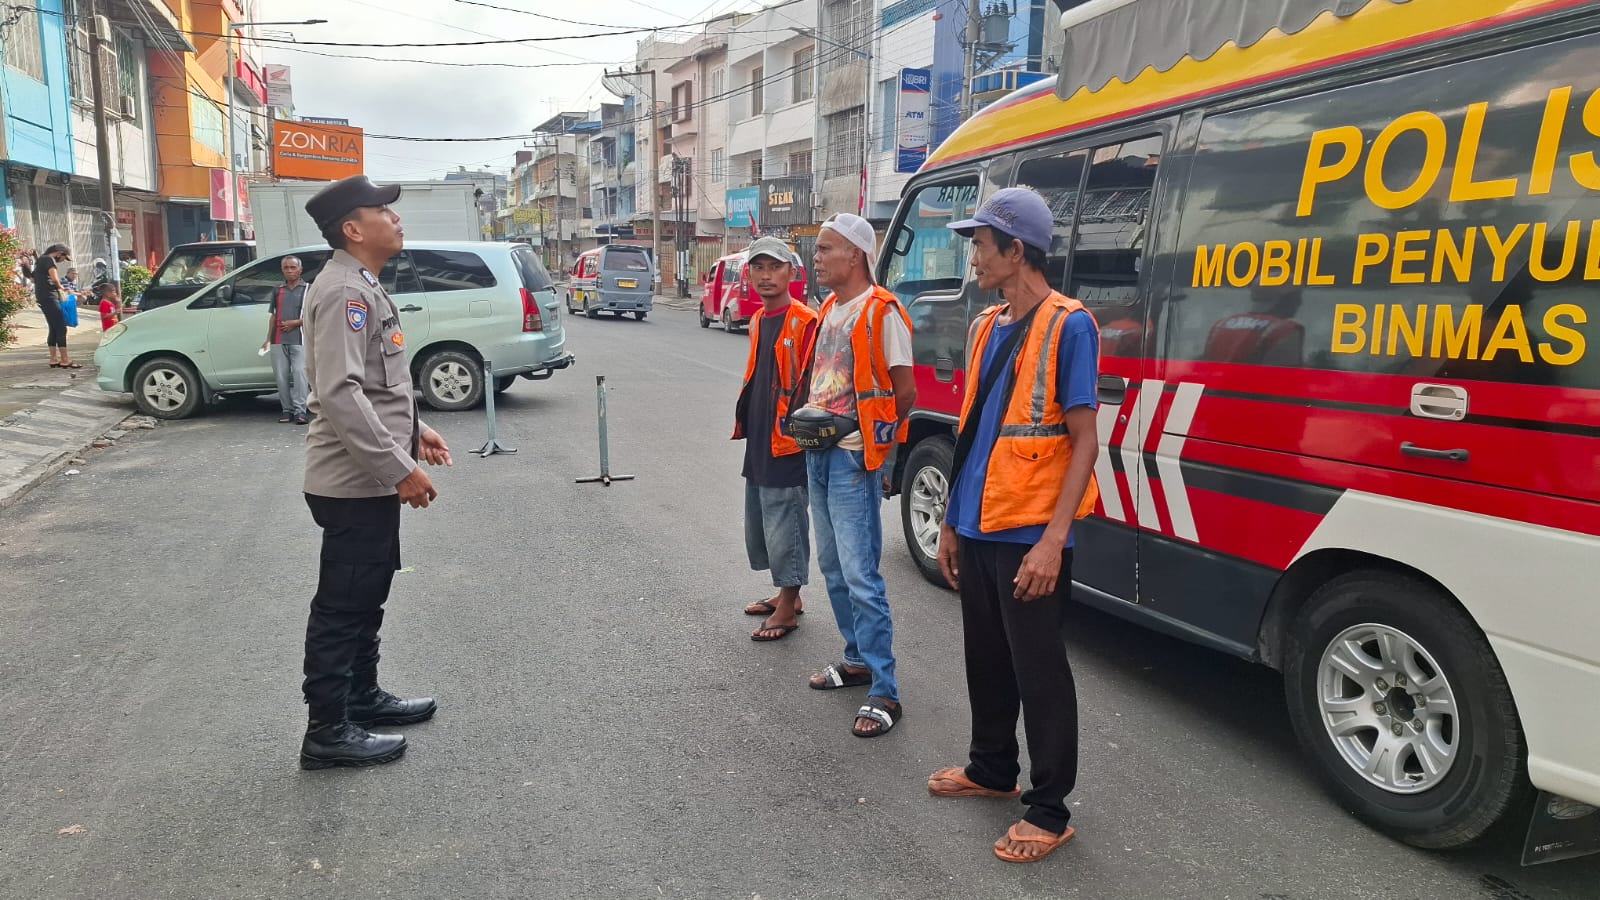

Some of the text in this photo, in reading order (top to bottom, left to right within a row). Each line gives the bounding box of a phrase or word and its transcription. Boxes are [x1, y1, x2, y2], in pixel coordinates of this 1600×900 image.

[279, 130, 359, 154] ZONRIA
[768, 192, 794, 206] STEAK
[1192, 238, 1335, 288] MOBIL
[1331, 304, 1587, 365] BINMAS
